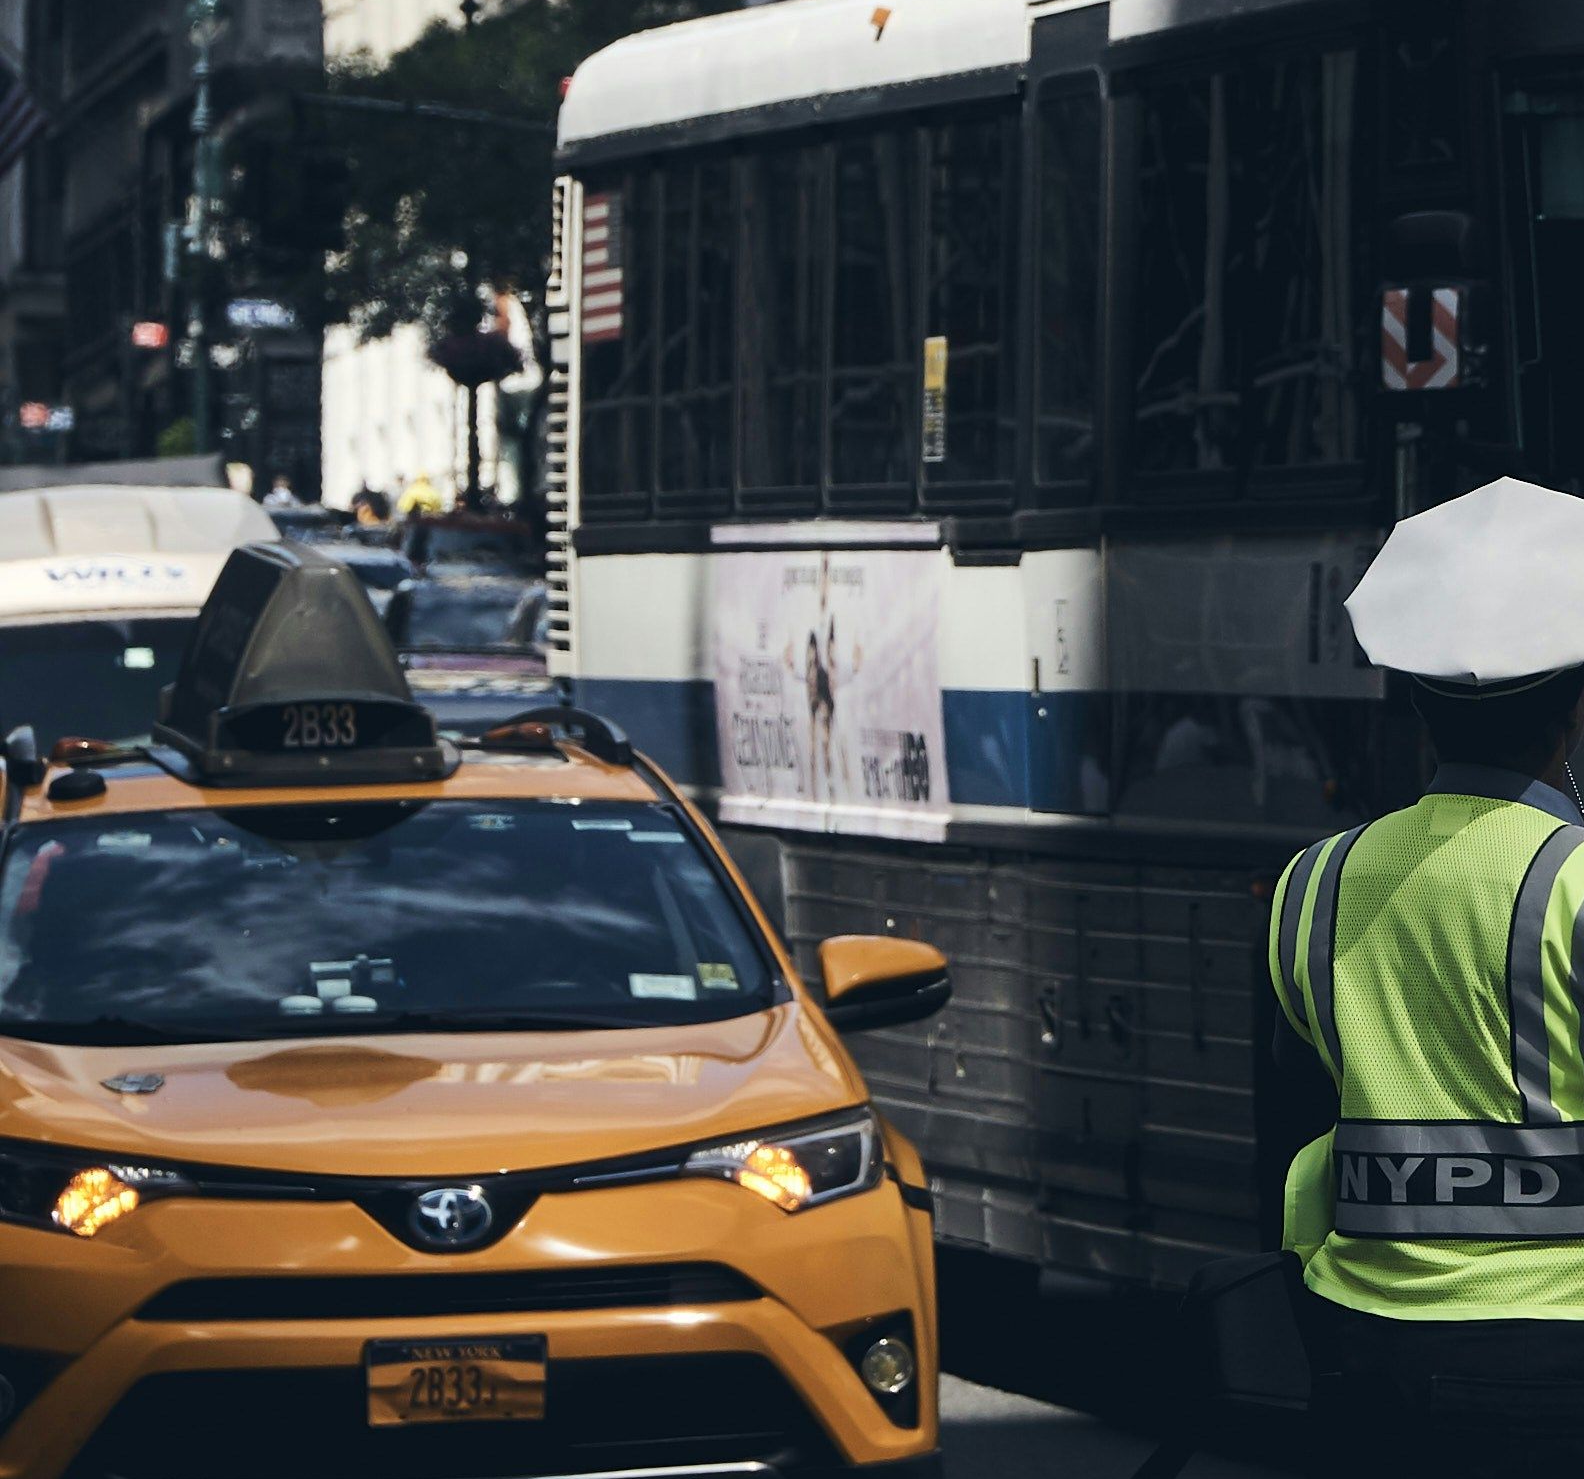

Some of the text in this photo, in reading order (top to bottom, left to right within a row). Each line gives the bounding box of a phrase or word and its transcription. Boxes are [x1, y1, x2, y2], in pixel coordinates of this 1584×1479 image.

[281, 703, 358, 747] 2B33
[1340, 1154, 1561, 1204] NYPD
[411, 1344, 502, 1362] NEW YORK
